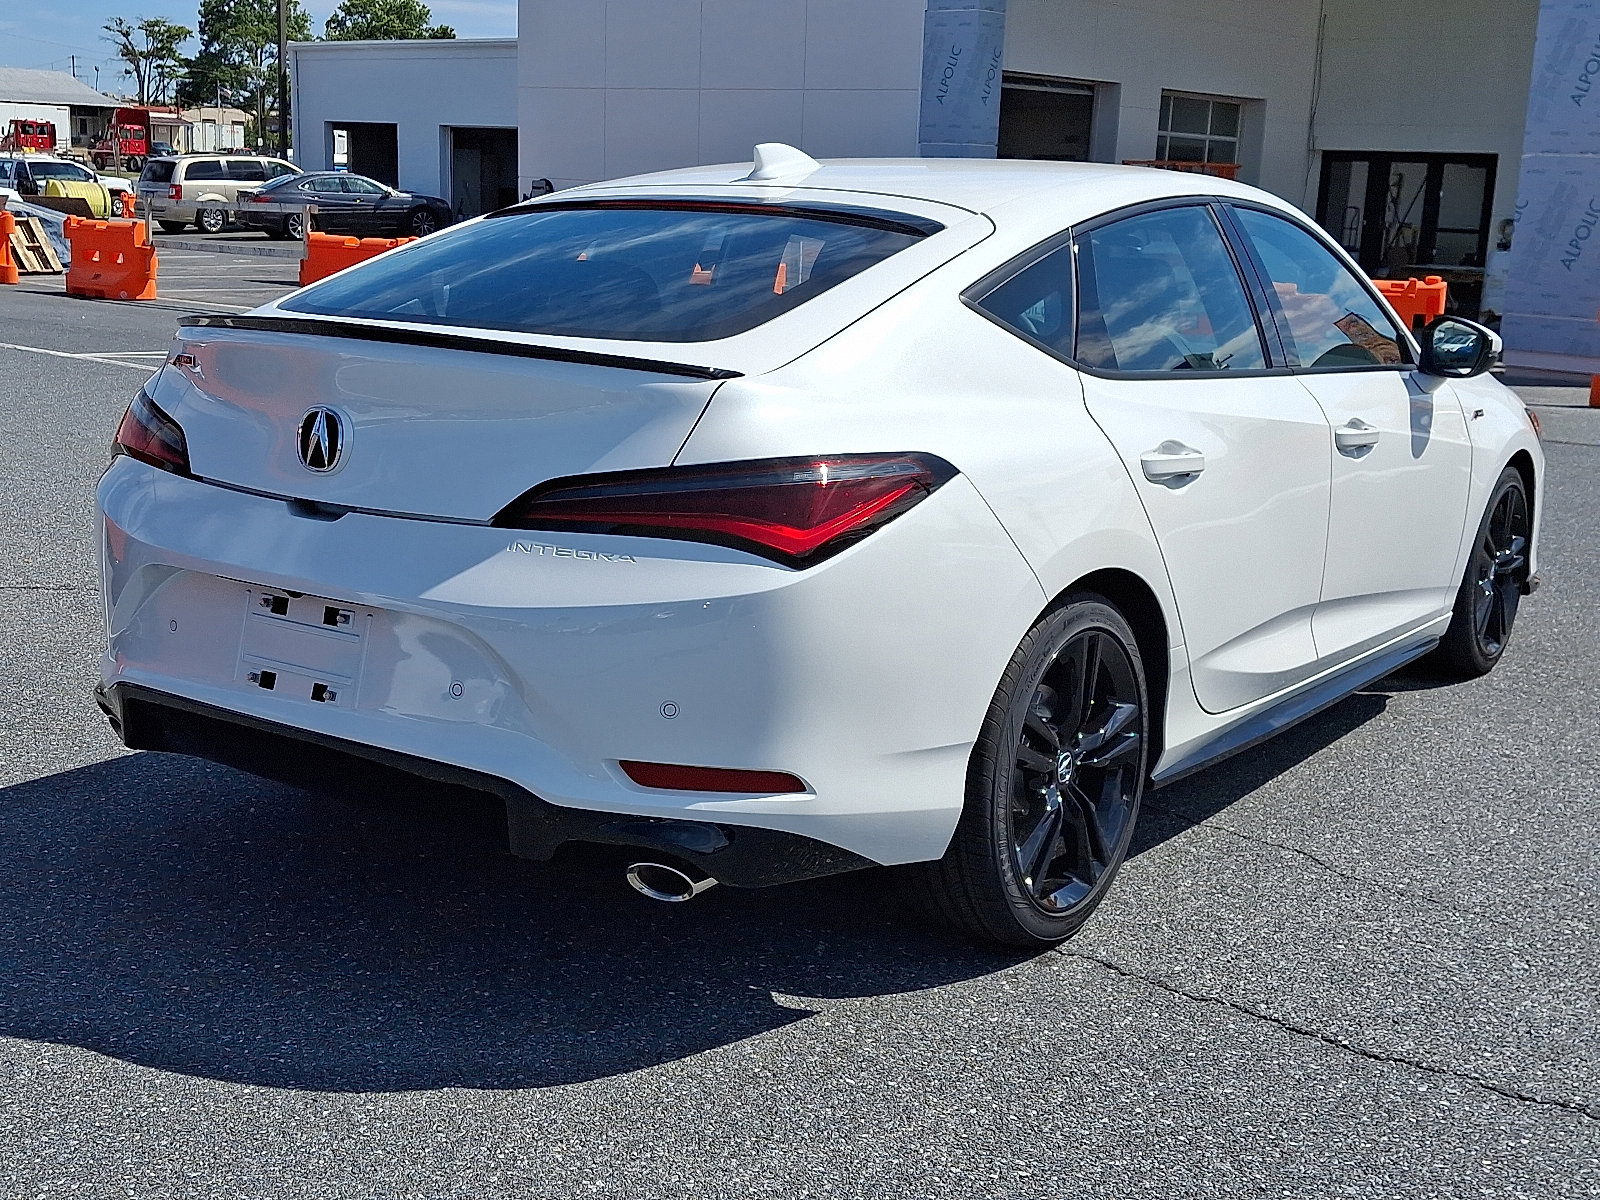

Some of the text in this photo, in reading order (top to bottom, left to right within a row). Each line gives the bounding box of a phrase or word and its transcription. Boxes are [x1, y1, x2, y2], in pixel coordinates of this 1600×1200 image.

[936, 45, 962, 105] ALPOLIC
[981, 47, 1002, 106] ALPOLIC
[1560, 195, 1600, 271] ALPOLIC
[506, 541, 637, 564] INTEGRA
